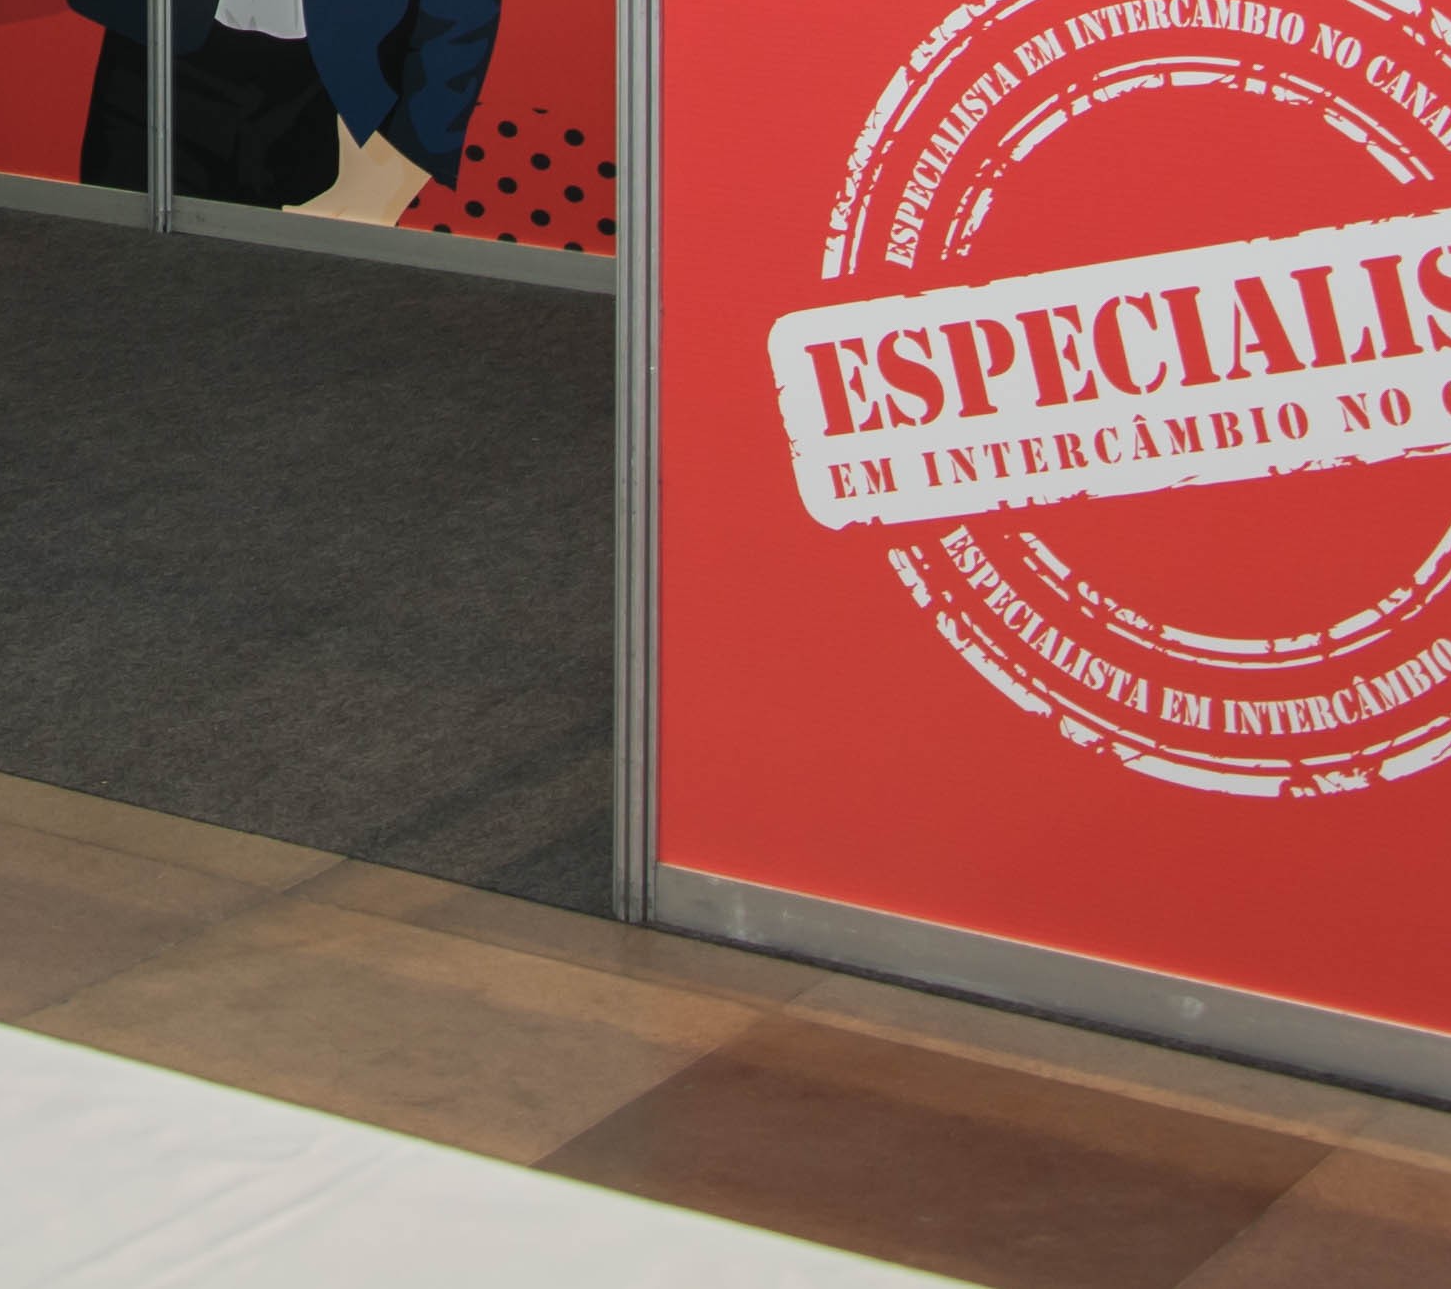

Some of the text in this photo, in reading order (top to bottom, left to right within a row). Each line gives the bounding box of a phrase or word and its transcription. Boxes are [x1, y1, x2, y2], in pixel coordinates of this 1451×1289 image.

[885, 62, 1021, 269] ESPECIALISTA
[1013, 28, 1067, 77] EM
[1311, 22, 1363, 70] NO
[826, 458, 898, 501] EM
[925, 401, 1307, 488] INTERCÂMBIO
[1341, 387, 1413, 431] NO
[939, 524, 1149, 714] ESPECIALISTA
[1161, 686, 1212, 731] EM
